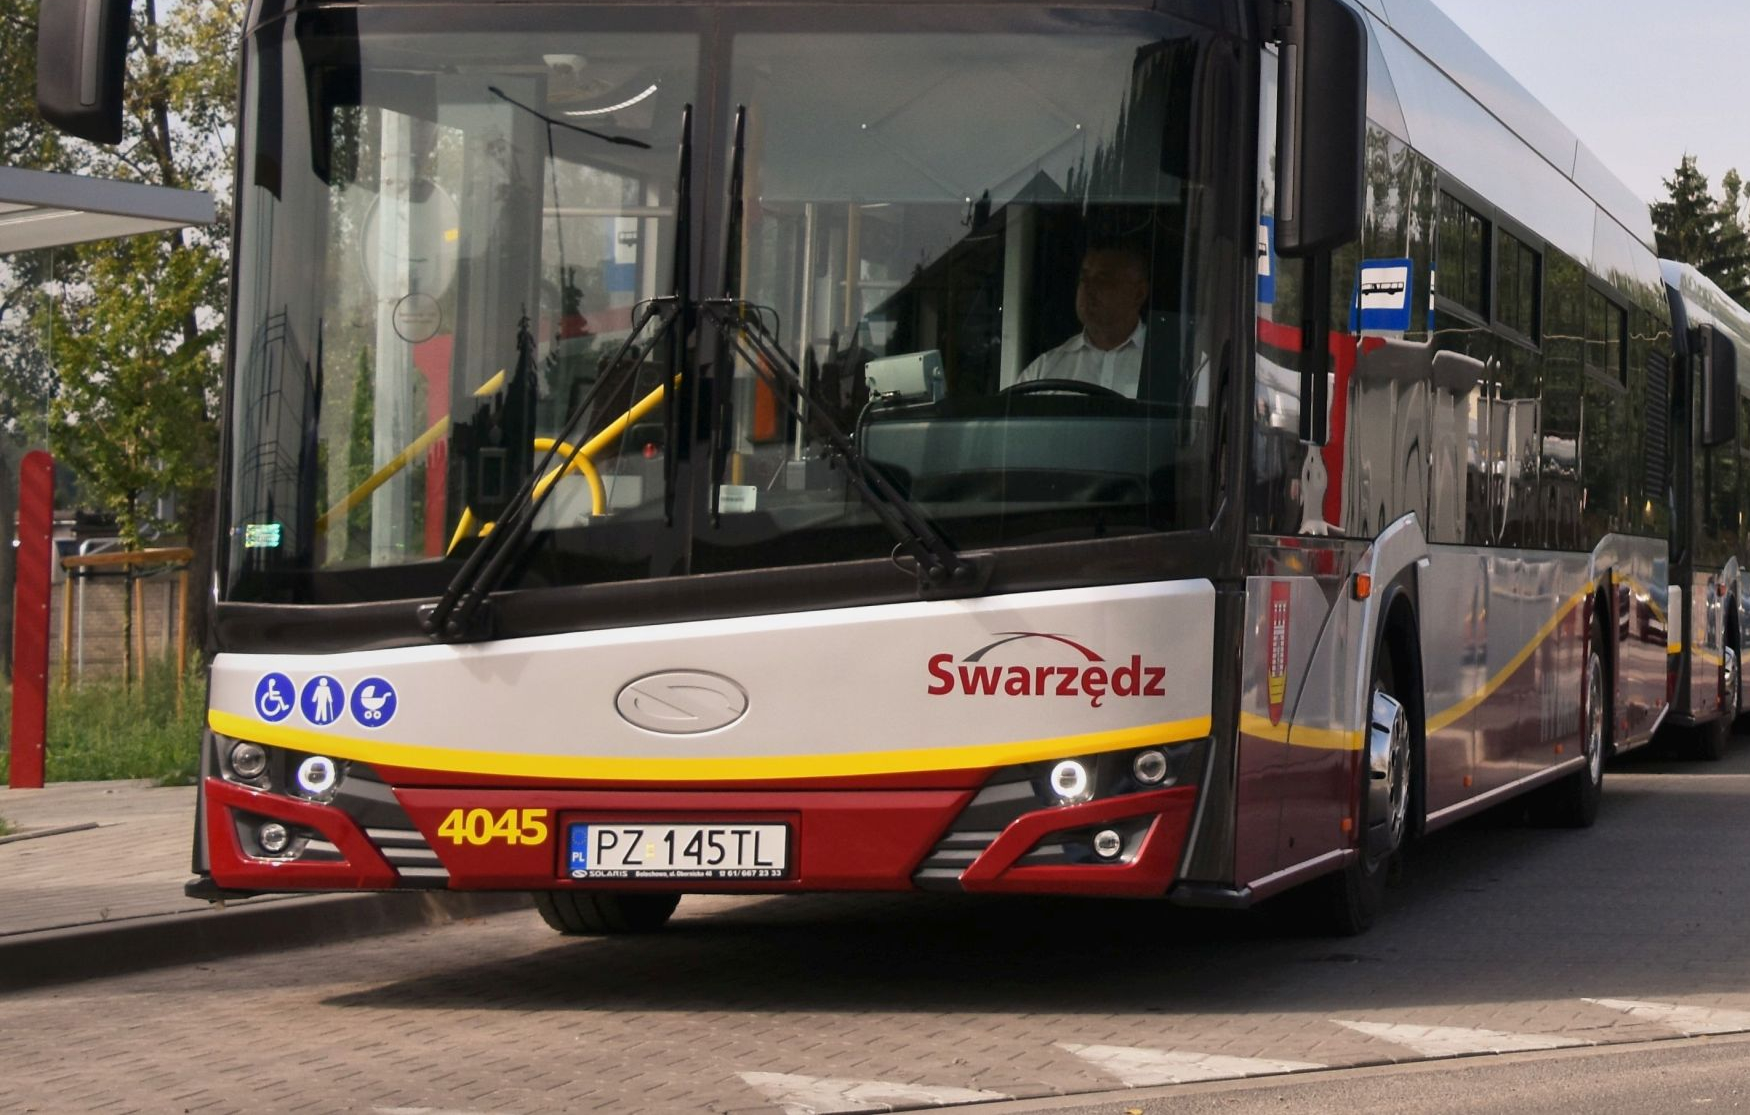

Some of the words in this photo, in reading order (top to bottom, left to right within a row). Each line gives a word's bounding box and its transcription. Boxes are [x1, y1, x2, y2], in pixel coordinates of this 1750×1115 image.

[927, 653, 1166, 708] Swarzędz
[438, 808, 548, 845] 4045
[572, 852, 585, 863] PL
[596, 829, 644, 865] PZ
[663, 829, 773, 867] 145TL
